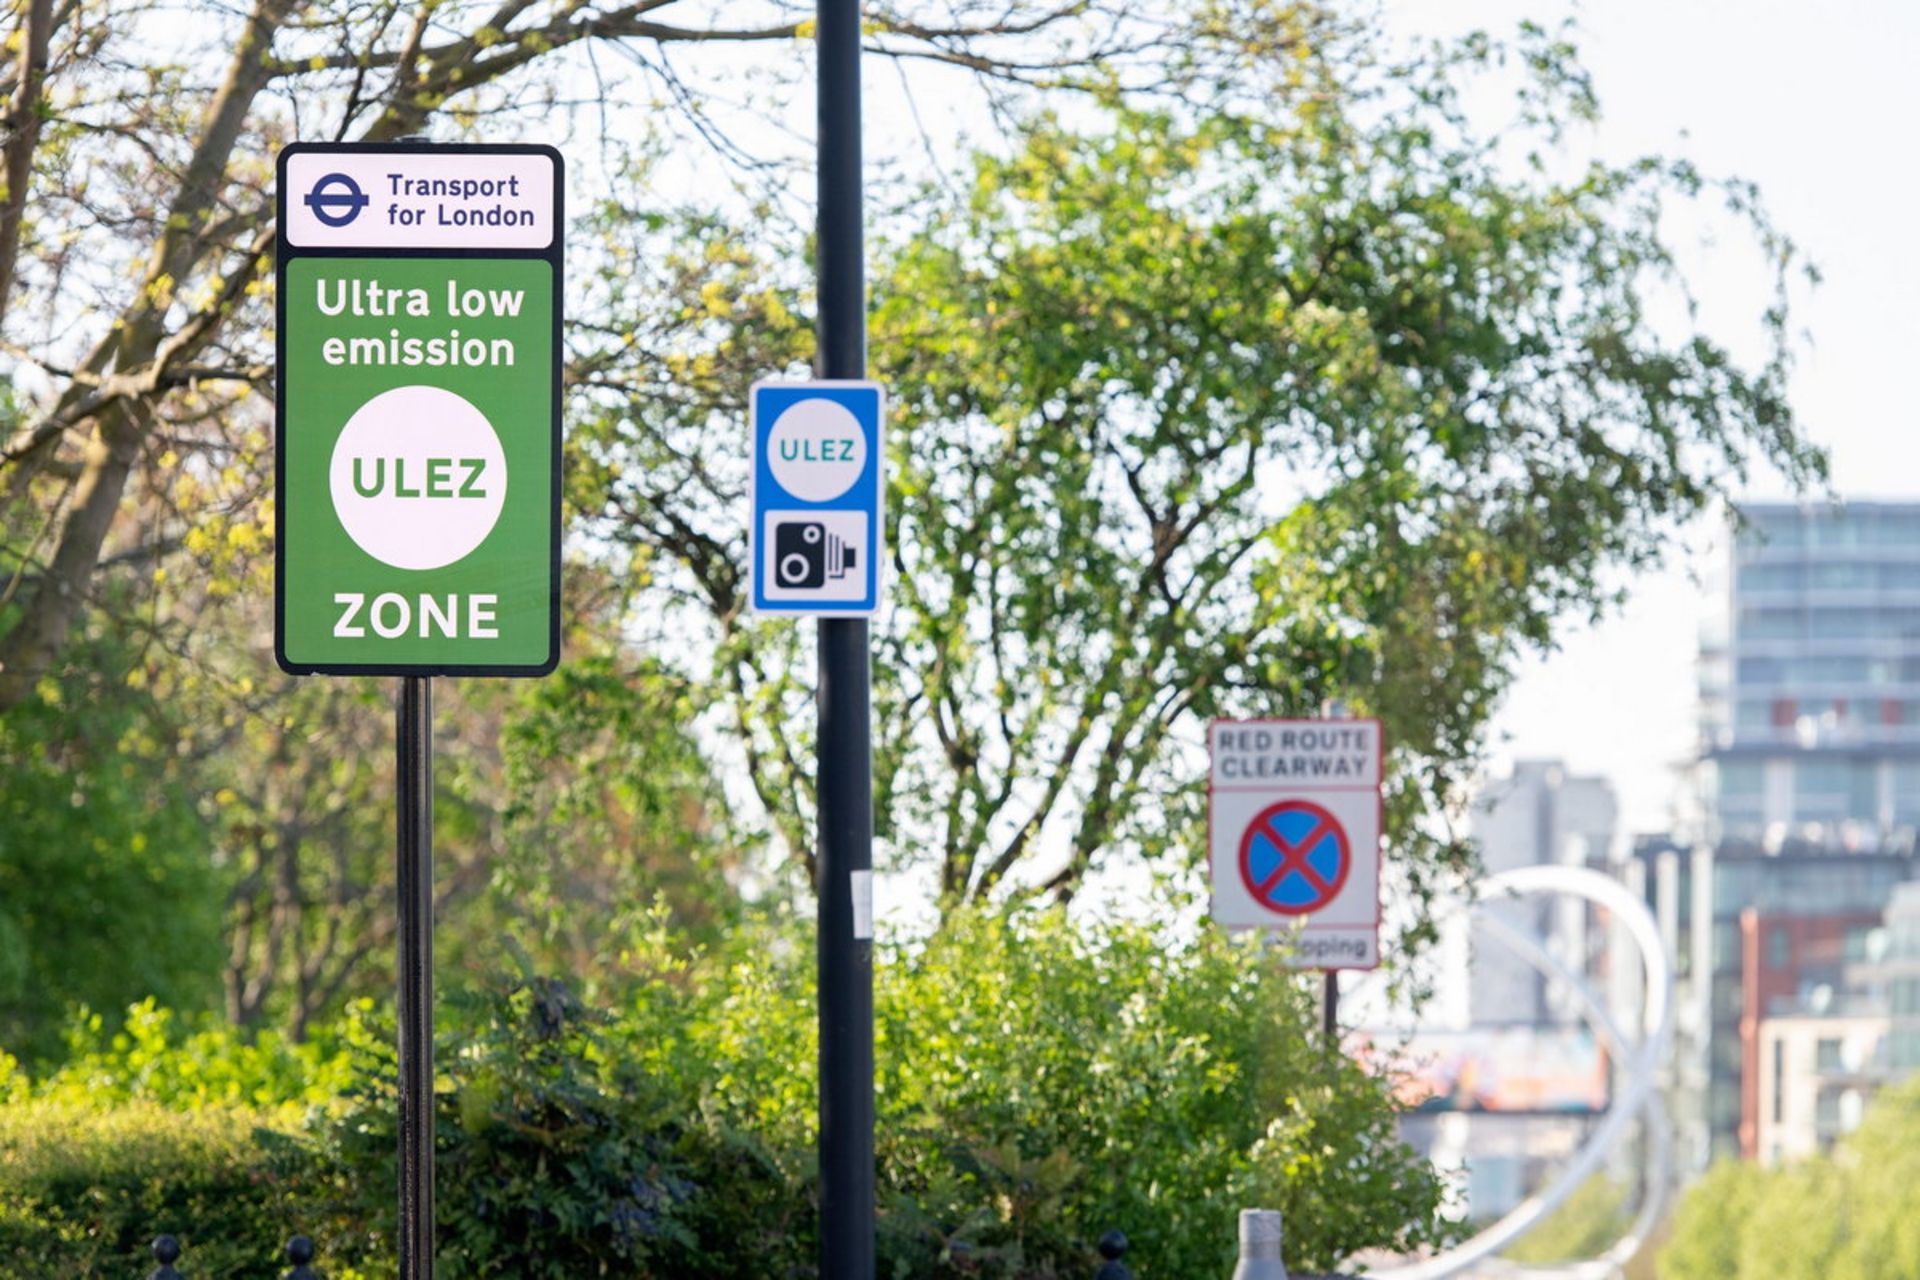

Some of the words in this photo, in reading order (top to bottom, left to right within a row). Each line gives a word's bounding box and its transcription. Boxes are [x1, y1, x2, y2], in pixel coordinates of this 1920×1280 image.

[387, 174, 519, 199] Transport
[388, 203, 426, 226] for
[438, 204, 535, 227] London
[317, 279, 430, 317] Ultra
[447, 280, 525, 317] low
[322, 328, 515, 367] emission
[780, 439, 854, 461] ULEZ
[353, 457, 487, 499] ULEZ
[333, 592, 499, 639] ZONE
[1219, 730, 1271, 749] RED
[1283, 730, 1370, 750] ROUTE
[1221, 756, 1367, 778] CLEARWAY
